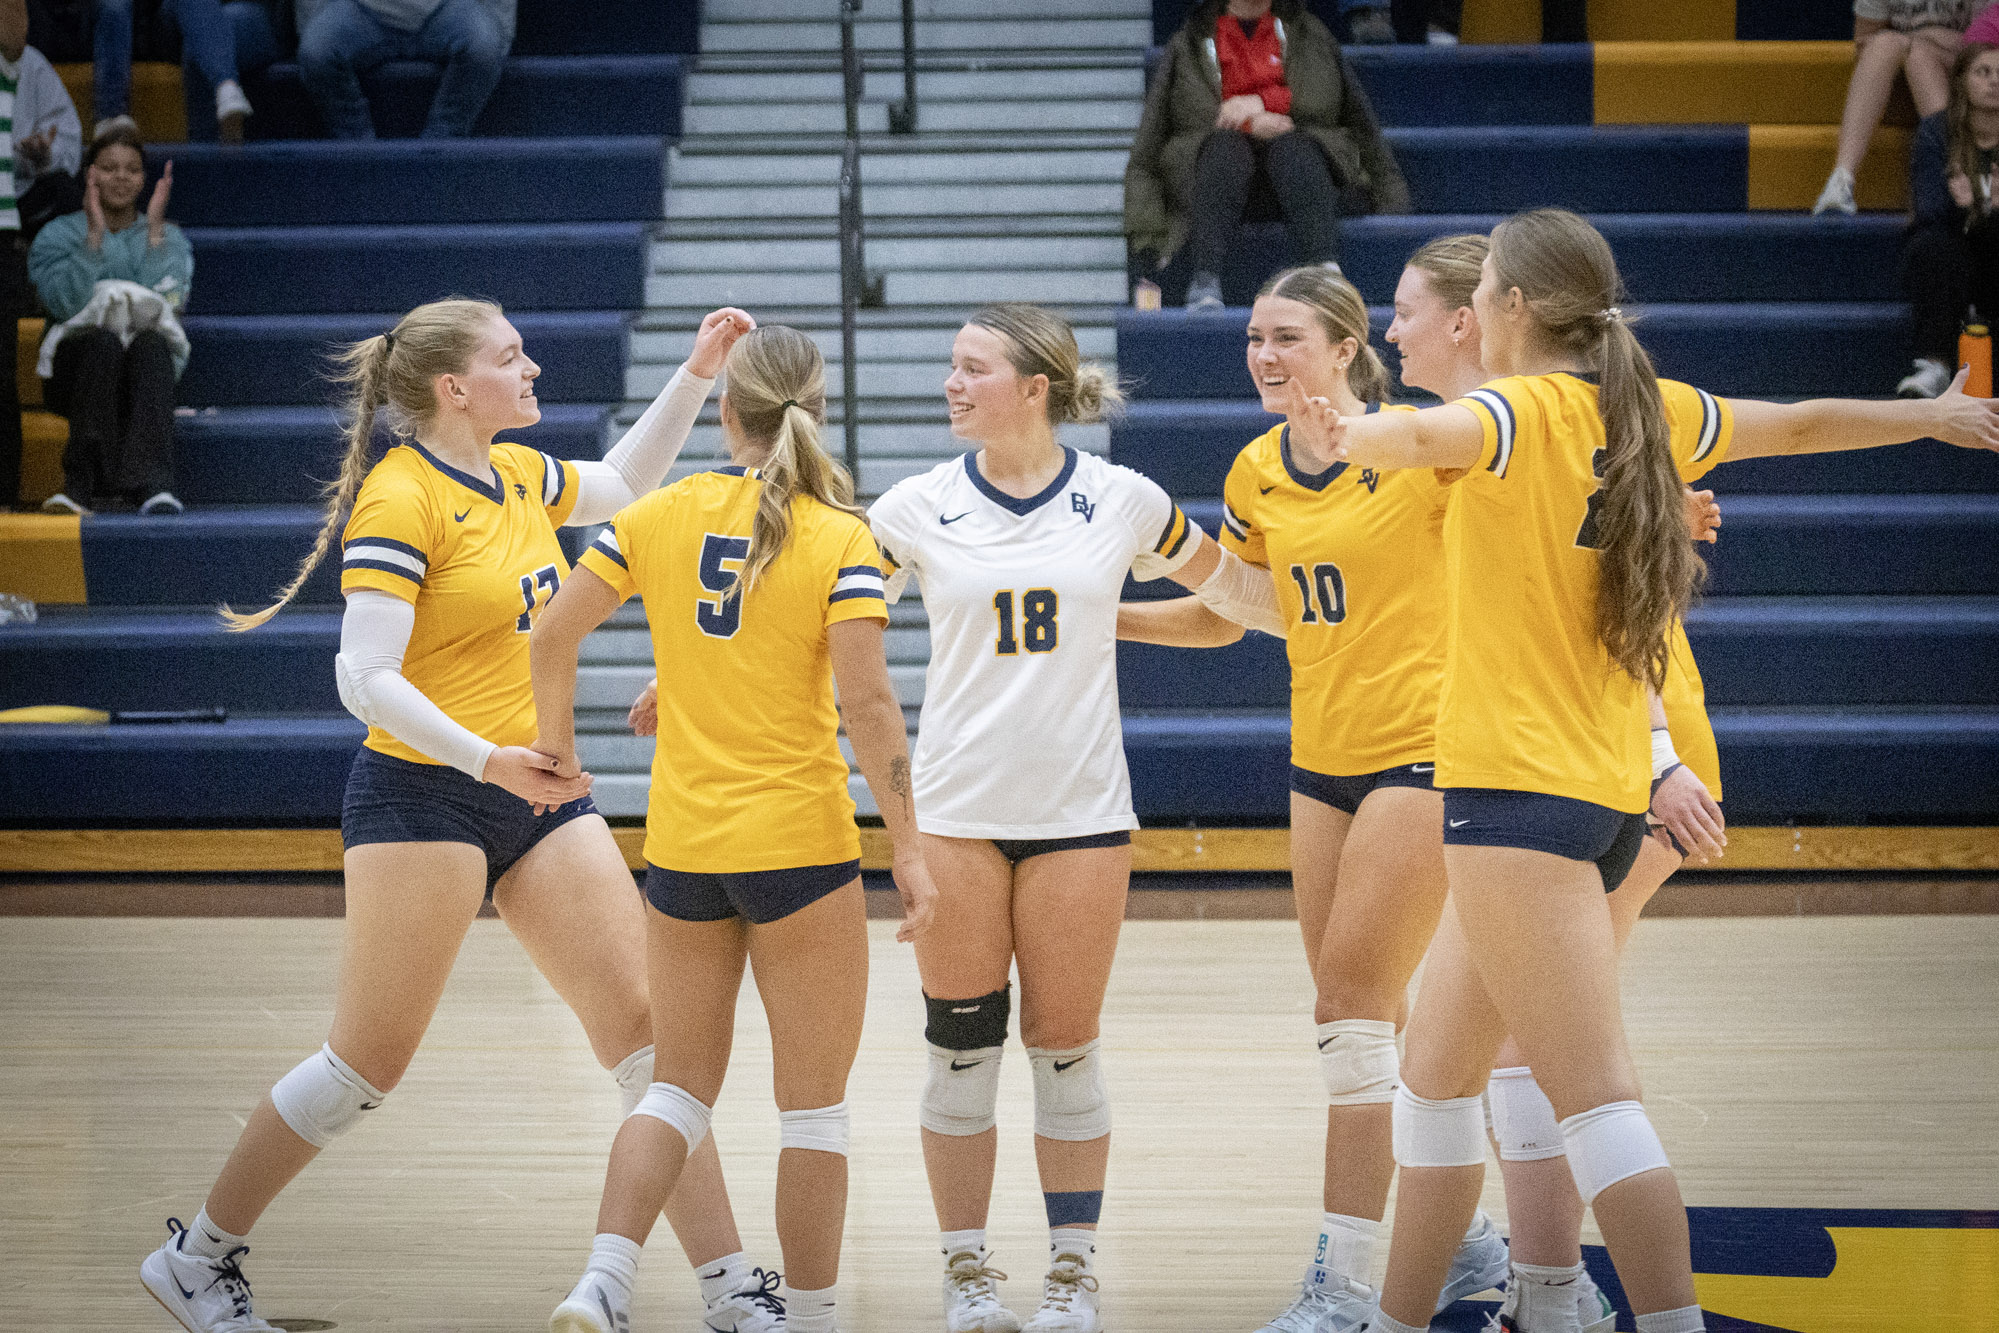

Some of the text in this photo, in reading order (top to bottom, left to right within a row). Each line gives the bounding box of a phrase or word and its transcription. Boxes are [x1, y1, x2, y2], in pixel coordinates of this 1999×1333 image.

[1071, 492, 1096, 524] BV
[695, 532, 752, 640] 5
[1289, 562, 1348, 626] 10
[992, 587, 1059, 656] 18
